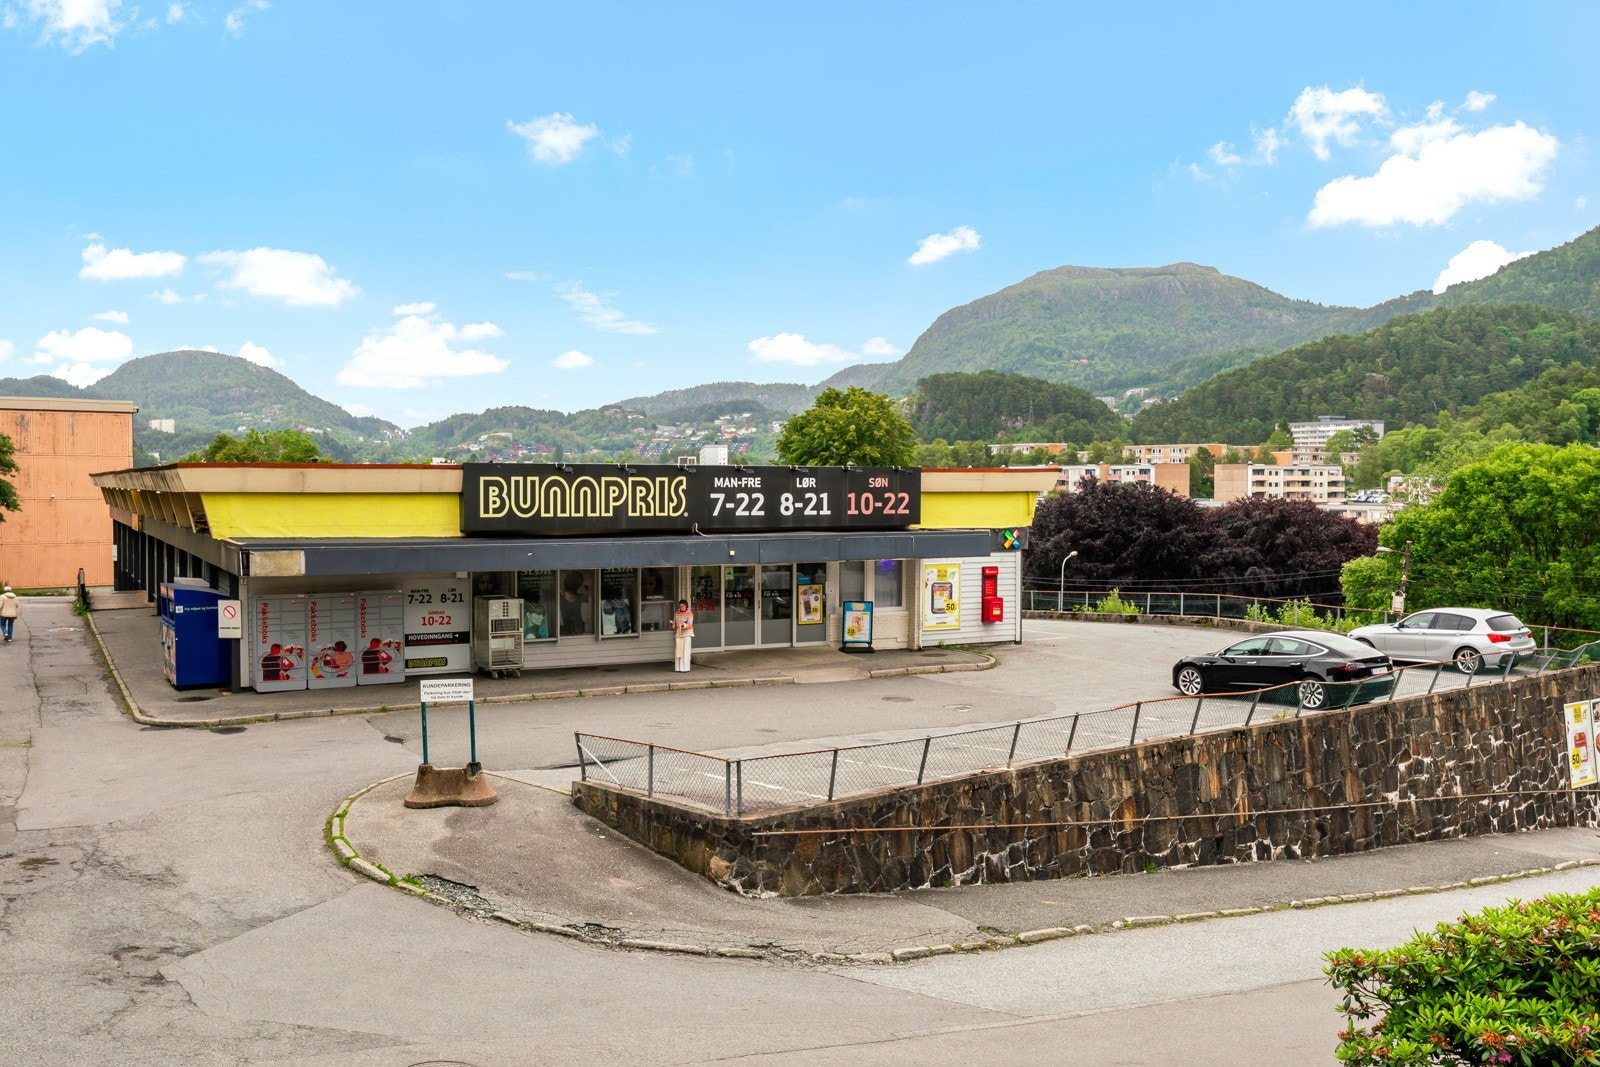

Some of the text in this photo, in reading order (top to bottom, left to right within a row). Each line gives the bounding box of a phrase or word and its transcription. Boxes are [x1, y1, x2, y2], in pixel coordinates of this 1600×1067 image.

[714, 477, 889, 488] MAN-FRE LØR SØN
[710, 492, 910, 516] 7-22 8-21 10-22
[408, 593, 464, 604] 7-22 8-21
[945, 603, 955, 611] 50
[261, 602, 269, 645] Pakkeboks
[310, 601, 318, 643] Pakkeboks
[421, 616, 452, 626] 10-22
